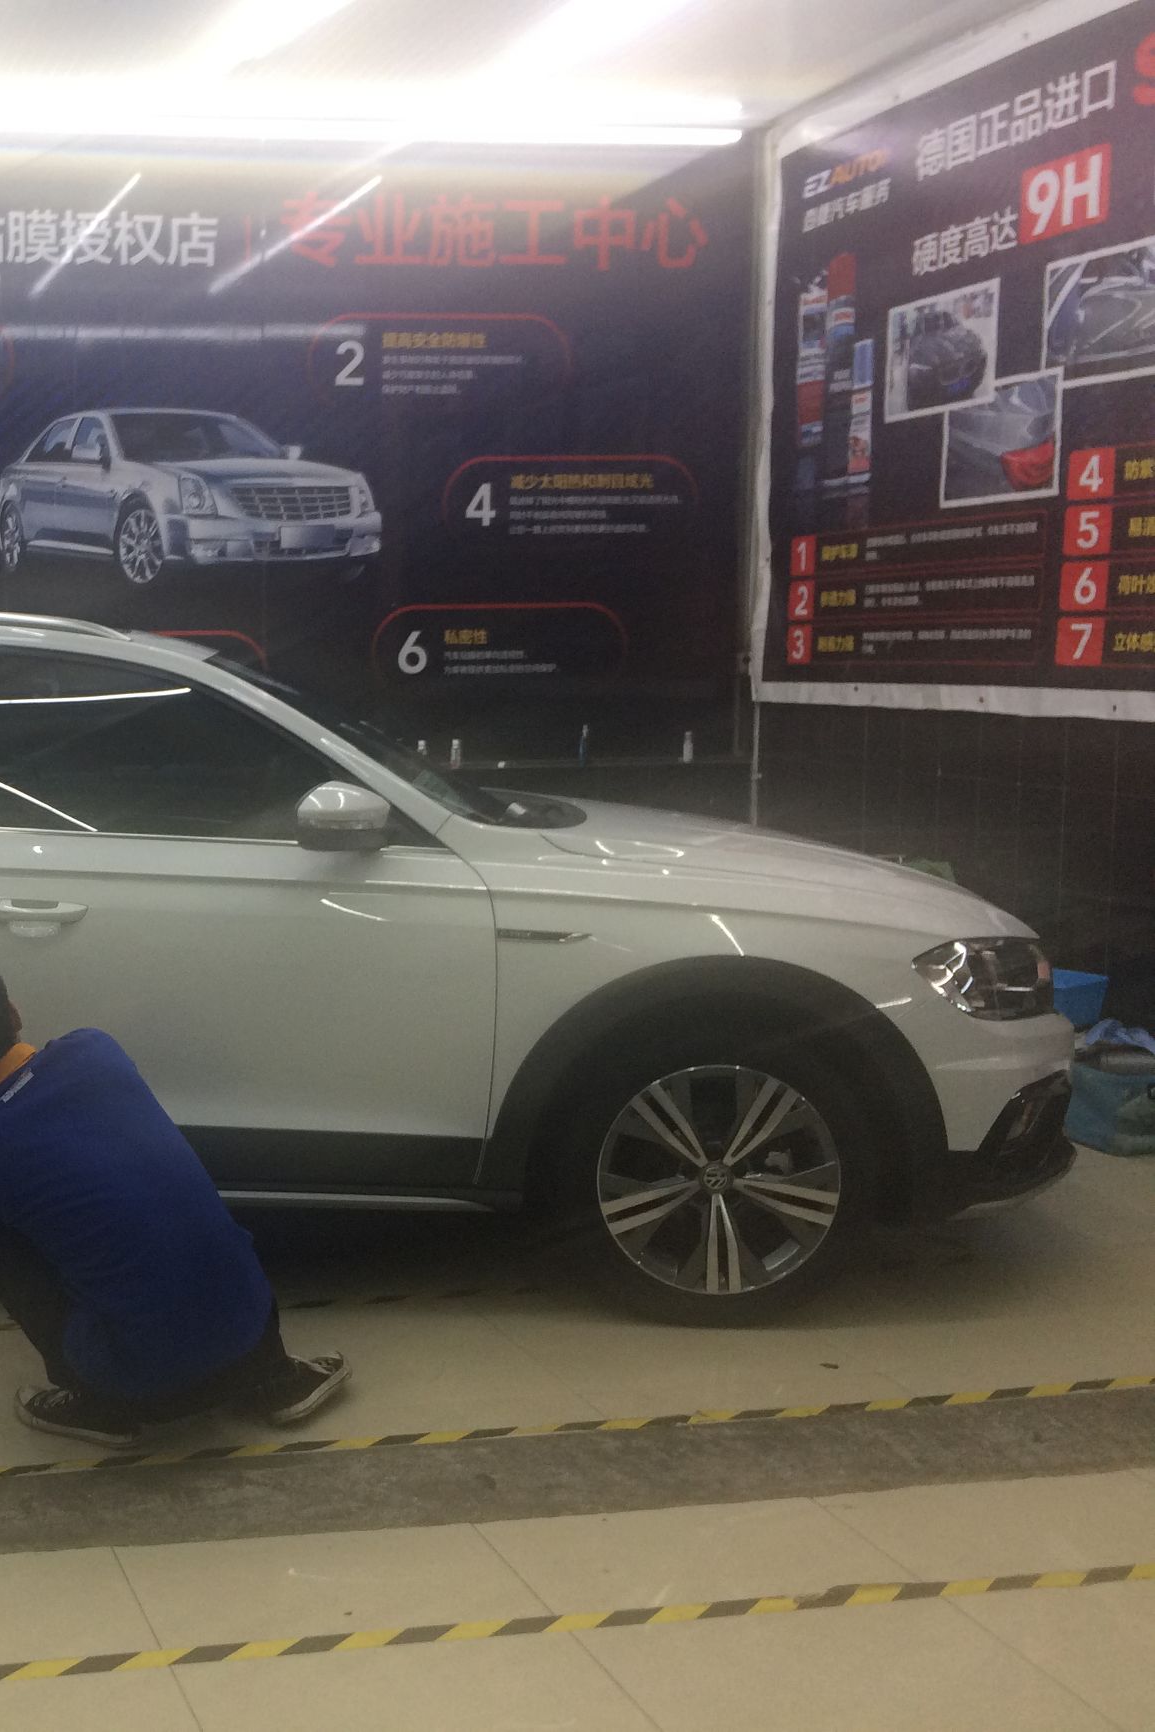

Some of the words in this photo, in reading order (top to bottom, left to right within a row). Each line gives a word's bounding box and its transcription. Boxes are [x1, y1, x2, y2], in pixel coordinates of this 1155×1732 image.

[915, 60, 1117, 181] 德国正品进口
[281, 191, 709, 273] 专业施工中心
[912, 206, 1018, 276] 硬度高达
[1026, 152, 1103, 237] 9H
[335, 340, 364, 386] 2
[1078, 455, 1103, 492] 4
[465, 482, 496, 527] 4
[1076, 511, 1099, 549] 5
[797, 542, 807, 571] 1
[795, 586, 808, 616] 2
[1073, 567, 1096, 604] 6
[398, 630, 427, 674] 6
[792, 630, 804, 659] 3
[1070, 623, 1093, 660] 7
